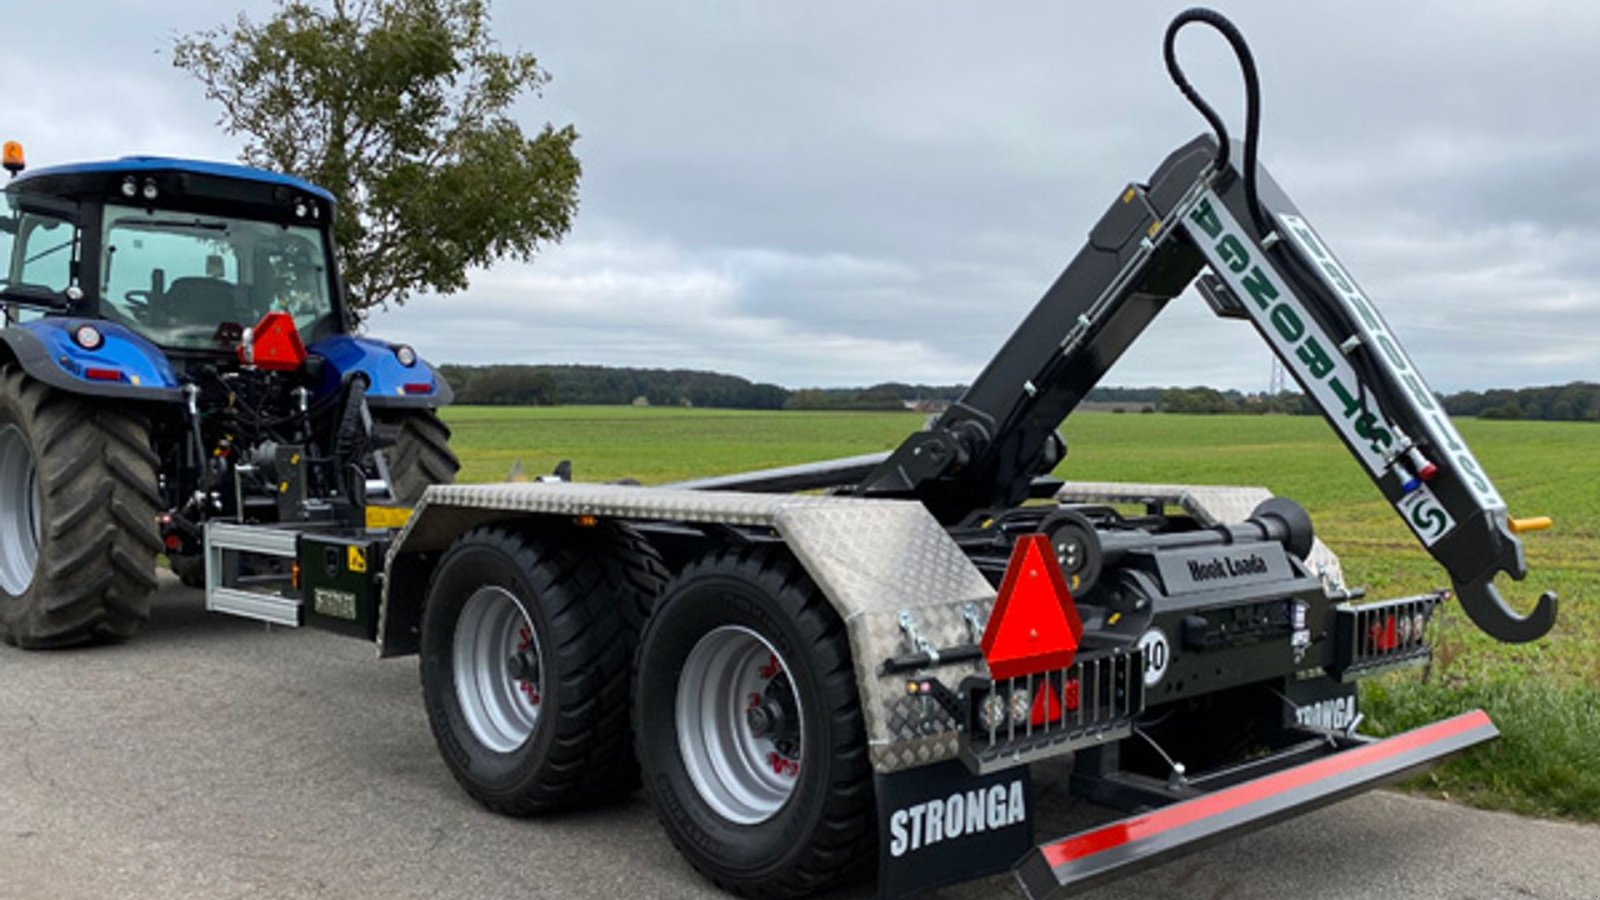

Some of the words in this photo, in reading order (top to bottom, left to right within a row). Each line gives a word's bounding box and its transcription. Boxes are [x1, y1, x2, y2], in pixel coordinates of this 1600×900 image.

[1189, 197, 1395, 457] STRONGA
[1291, 225, 1491, 497] STRONGA
[1295, 693, 1355, 728] TRONGA
[887, 780, 1026, 857] STRONGA
